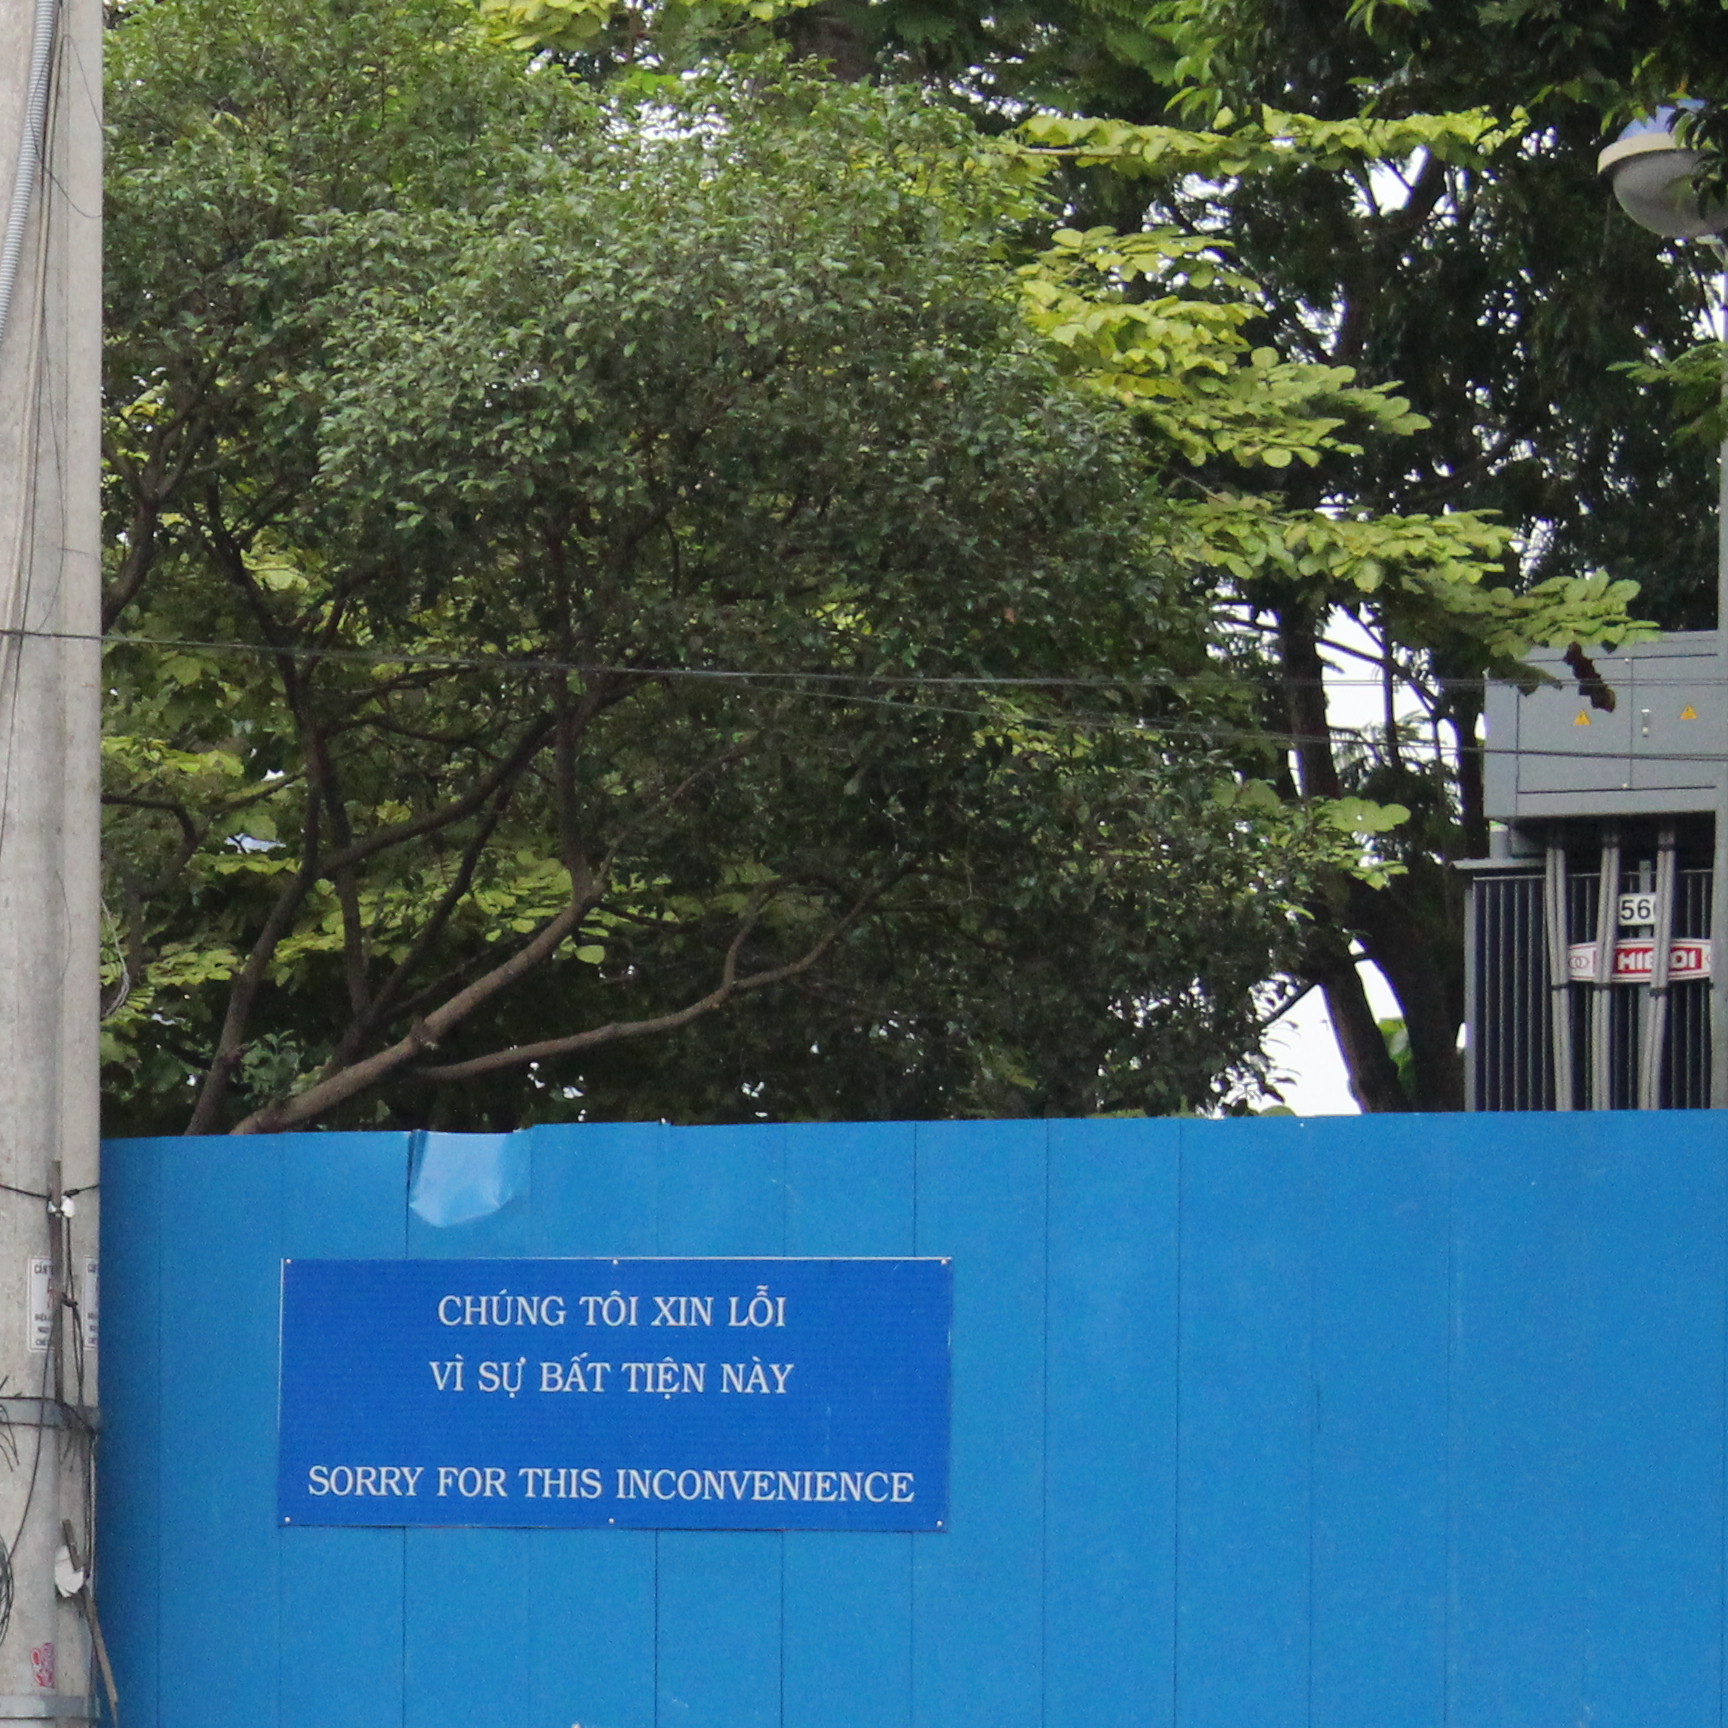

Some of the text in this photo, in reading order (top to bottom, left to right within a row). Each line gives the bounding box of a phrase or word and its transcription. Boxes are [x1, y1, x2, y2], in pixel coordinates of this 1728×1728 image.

[1621, 899, 1655, 920] 56
[437, 1284, 787, 1328] CHÚNG TÔI XIN LỖI
[429, 1353, 794, 1400] VÌ SỰ BẤT TIỆN NÀY
[307, 1465, 915, 1503] SORRY FOR THIS INCONVENIENCE
